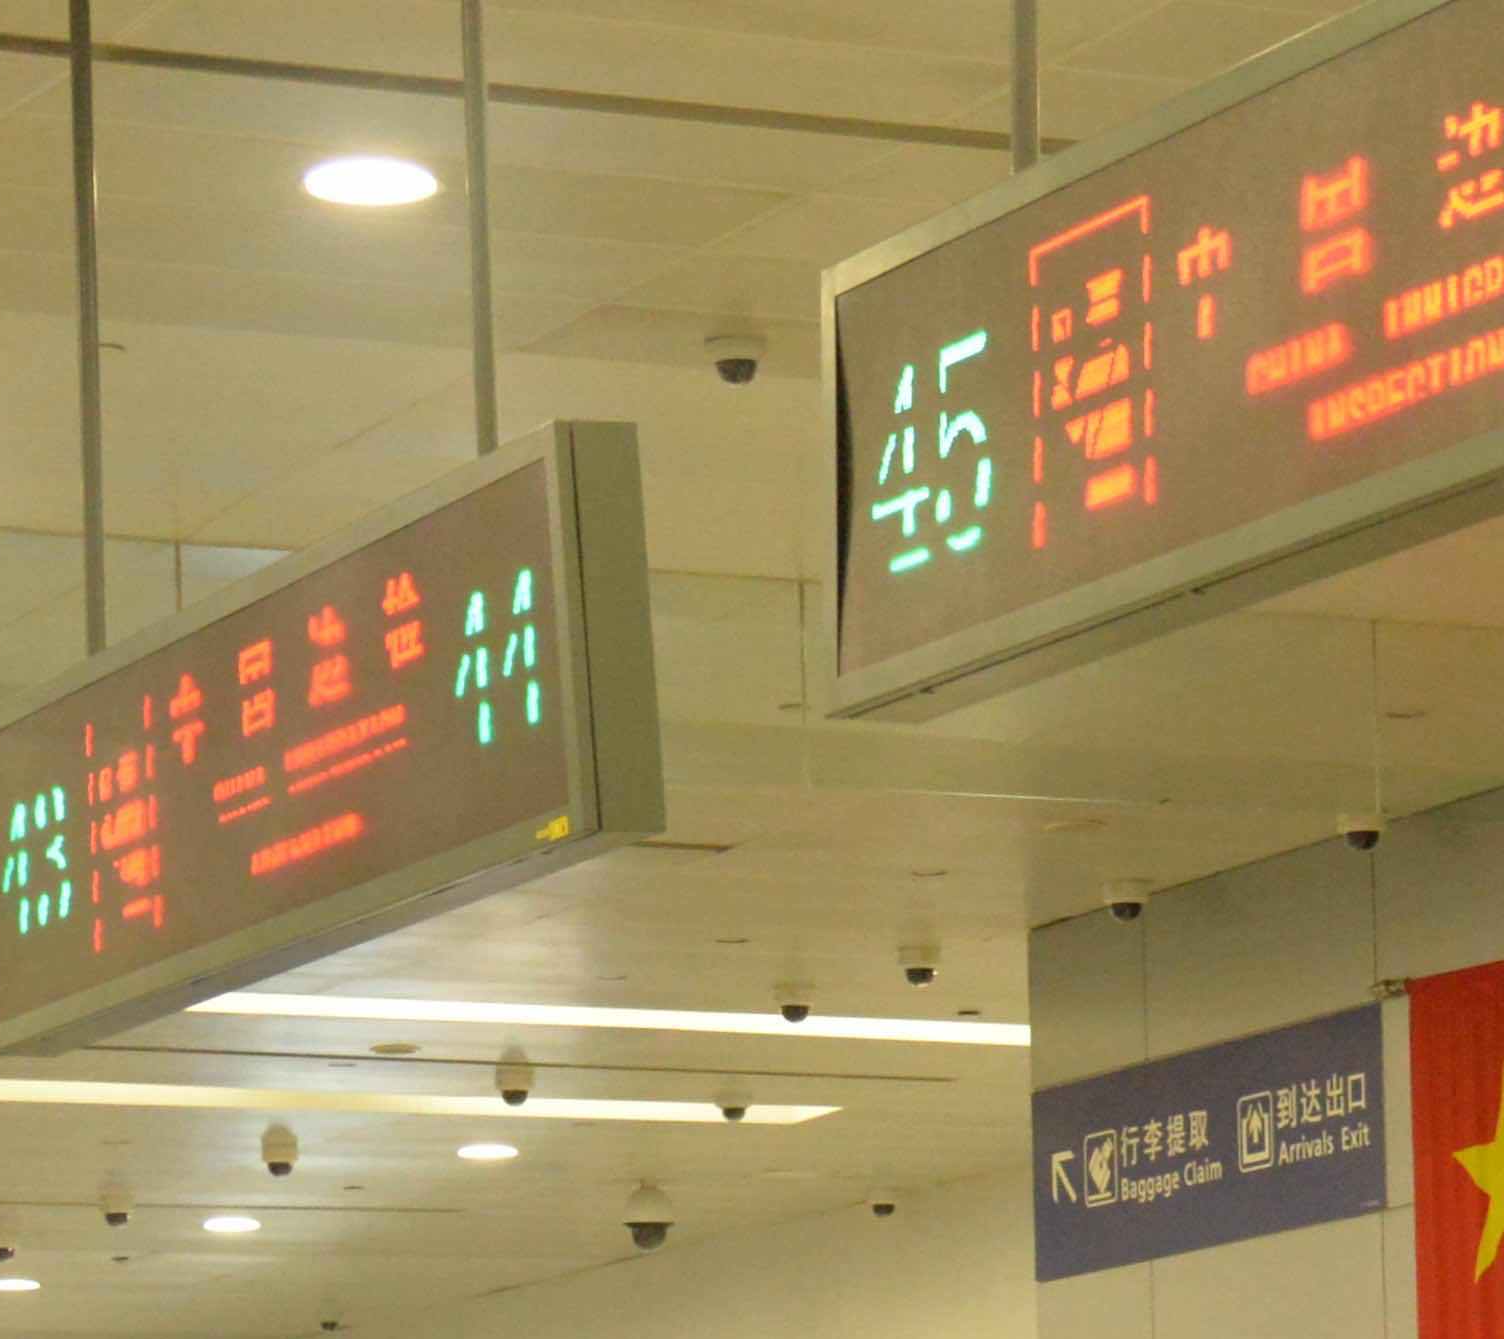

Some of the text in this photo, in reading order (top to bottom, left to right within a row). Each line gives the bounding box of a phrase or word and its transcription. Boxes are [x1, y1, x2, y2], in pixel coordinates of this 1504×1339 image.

[1277, 1073, 1367, 1129] 到达出口
[1120, 1110, 1209, 1168] 行李提取
[1278, 1122, 1371, 1167] Arrivals Exit
[1121, 1157, 1223, 1203] Baggage Claim
